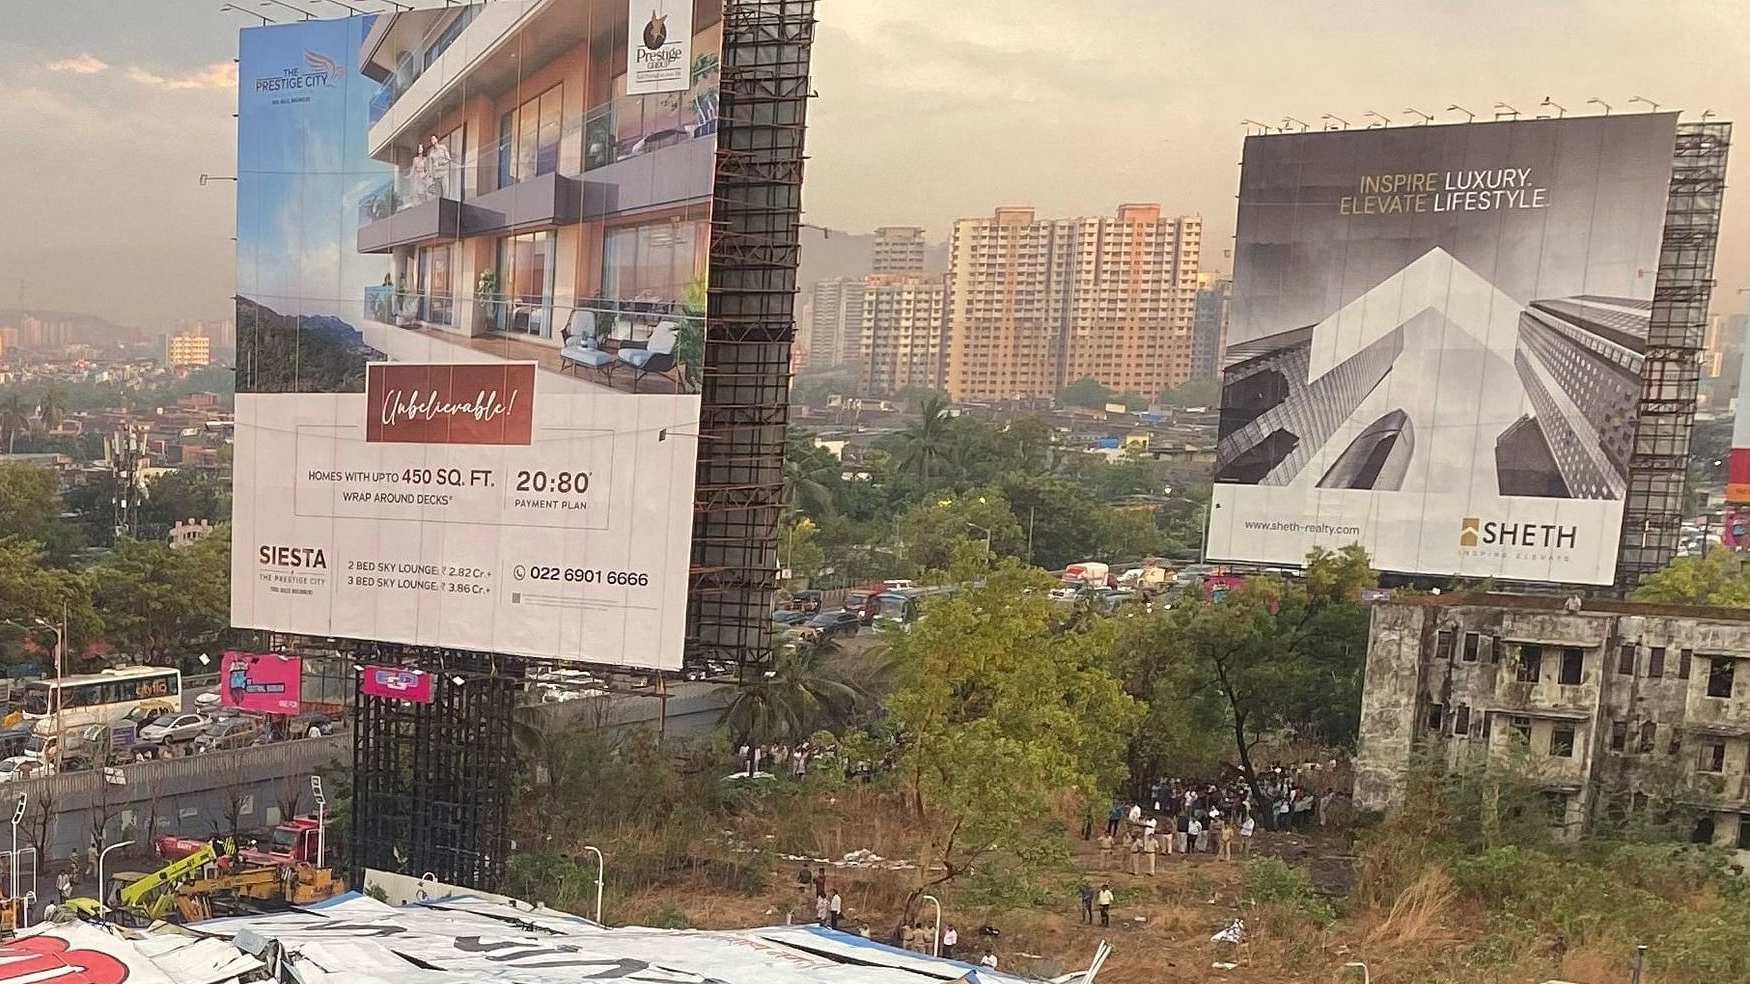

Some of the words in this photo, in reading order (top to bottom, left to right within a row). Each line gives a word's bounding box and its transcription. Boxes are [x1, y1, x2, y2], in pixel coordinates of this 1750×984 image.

[636, 47, 682, 63] Prestige
[283, 67, 299, 77] THE
[256, 77, 303, 92] PRESTIGE
[305, 74, 328, 87] CITY
[1359, 172, 1439, 194] INSPIRE
[1444, 168, 1533, 193] LUXURY.
[1339, 192, 1427, 216] ELEVATE
[381, 388, 516, 428] Unbelievable!
[308, 470, 343, 483] HOMES
[345, 471, 371, 483] WITH
[372, 472, 400, 484] UPTO
[401, 467, 433, 486] 450
[436, 468, 466, 488] SQ.
[470, 470, 495, 487] FT.
[343, 490, 372, 504] WRAP
[373, 491, 416, 505] AROUND
[514, 498, 559, 511] PAYMENT
[561, 499, 588, 511] PLAN
[1244, 519, 1361, 538] www.sheth-realty.com
[1483, 521, 1577, 548] SHETH
[259, 545, 327, 569] SIESTA
[348, 561, 354, 570] 2
[356, 561, 375, 571] BED
[377, 562, 396, 573] SKY
[449, 567, 472, 578] 2.82
[530, 566, 560, 581] 022
[564, 568, 602, 584] 6901
[607, 571, 649, 587] 6666
[259, 573, 272, 582] THE
[274, 574, 307, 585] PRESTIGE
[309, 577, 326, 586] CITY
[347, 576, 354, 585] 3
[356, 577, 375, 586] BED
[377, 578, 396, 588] SKY
[448, 583, 471, 594] 3.86
